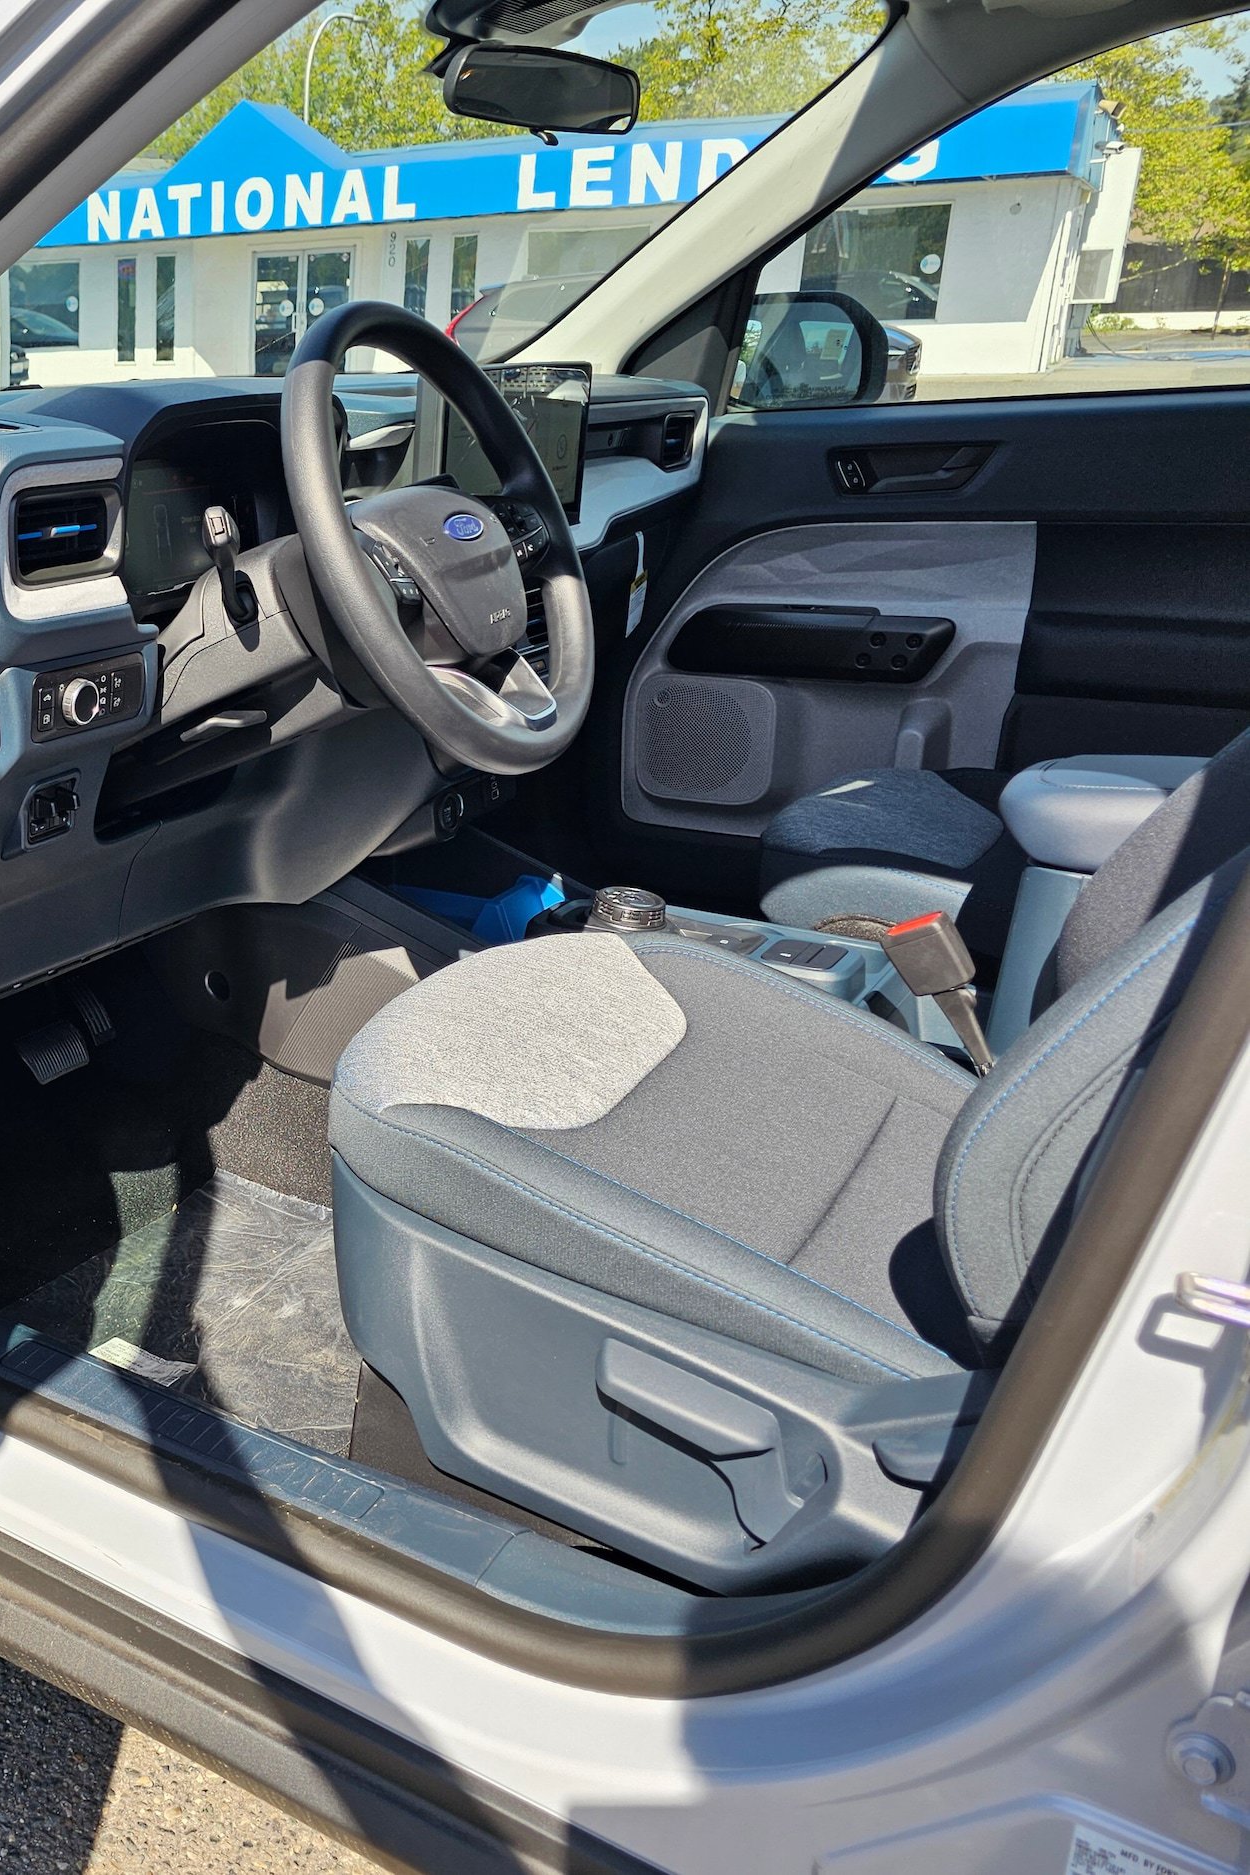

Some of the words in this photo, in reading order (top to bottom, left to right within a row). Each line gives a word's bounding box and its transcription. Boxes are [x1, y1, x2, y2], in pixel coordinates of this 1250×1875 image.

[88, 165, 416, 242] NATIONAL
[388, 231, 397, 268] 920
[453, 518, 479, 536] Ford
